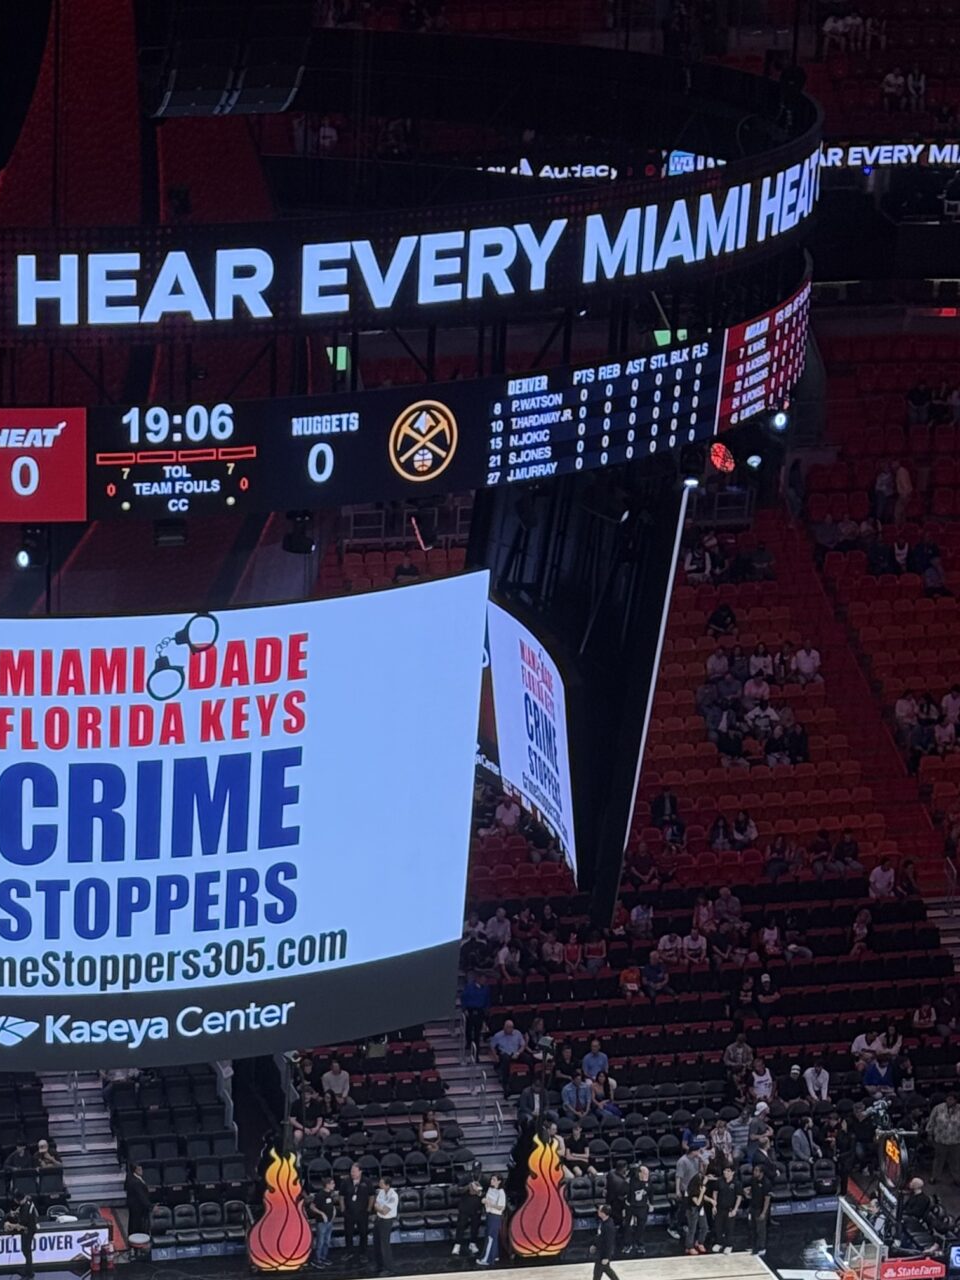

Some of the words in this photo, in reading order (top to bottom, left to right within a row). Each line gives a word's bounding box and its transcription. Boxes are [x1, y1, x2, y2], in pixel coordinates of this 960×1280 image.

[847, 144, 925, 166] EVERY
[16, 248, 275, 326] HEAR
[300, 219, 568, 316] EVERY
[581, 183, 750, 284] MIAMI
[757, 148, 820, 243] HEAT
[507, 374, 548, 396] DENVER
[573, 368, 595, 385] PTS
[598, 363, 621, 381] REB
[626, 358, 647, 375] AST
[650, 353, 668, 370] STL
[670, 347, 689, 365] BLK
[692, 342, 709, 360] FLS
[493, 402, 502, 415] 8
[511, 393, 563, 412] P.WATSON
[122, 402, 234, 445] 19:06
[291, 412, 360, 437] NUGGETS
[490, 419, 503, 433] 10
[489, 437, 503, 450] 15
[509, 429, 550, 447] N.JOKIC
[307, 442, 334, 483] 0
[488, 455, 501, 467] 21
[508, 446, 552, 465] S.JONES
[10, 456, 40, 497] 0
[122, 468, 131, 480] 7
[162, 465, 191, 479] TOL
[227, 462, 235, 475] 7
[486, 472, 500, 485] 27
[506, 461, 558, 482] J.MURRAY
[107, 483, 116, 497] 0
[133, 481, 171, 496] TEAM
[175, 479, 220, 494] FOULS
[240, 477, 249, 490] 0
[167, 499, 189, 512] CC
[187, 632, 308, 692] DADE
[199, 689, 307, 744] KEYS
[524, 692, 560, 776] CRIME
[528, 744, 563, 813] STOPPERS
[46, 1012, 170, 1049] Kaseya
[177, 1001, 296, 1038] Center
[39, 1234, 73, 1252] OVER
